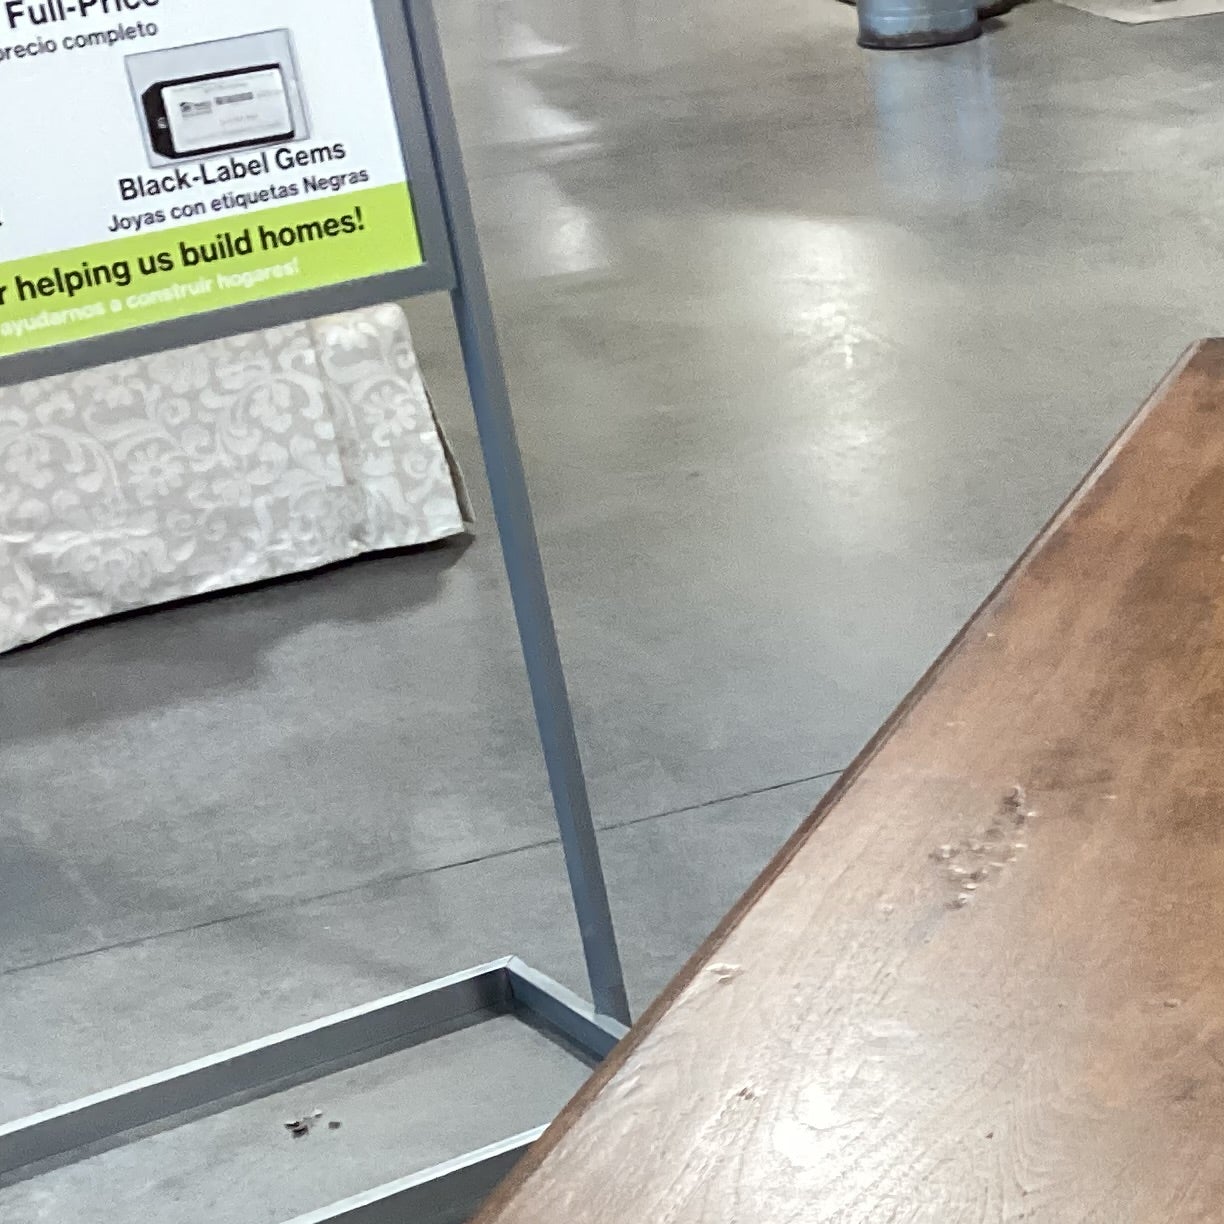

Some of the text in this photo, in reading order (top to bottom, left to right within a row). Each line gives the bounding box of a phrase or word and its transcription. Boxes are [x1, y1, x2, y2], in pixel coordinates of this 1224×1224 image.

[62, 21, 159, 47] completo
[107, 168, 370, 233] Joyas con etiquetas Negras
[118, 142, 347, 201] Black-Label Gems
[14, 261, 132, 299] helping
[137, 251, 175, 275] us
[178, 229, 253, 268] build
[258, 205, 365, 250] homes!
[125, 275, 213, 309] construir
